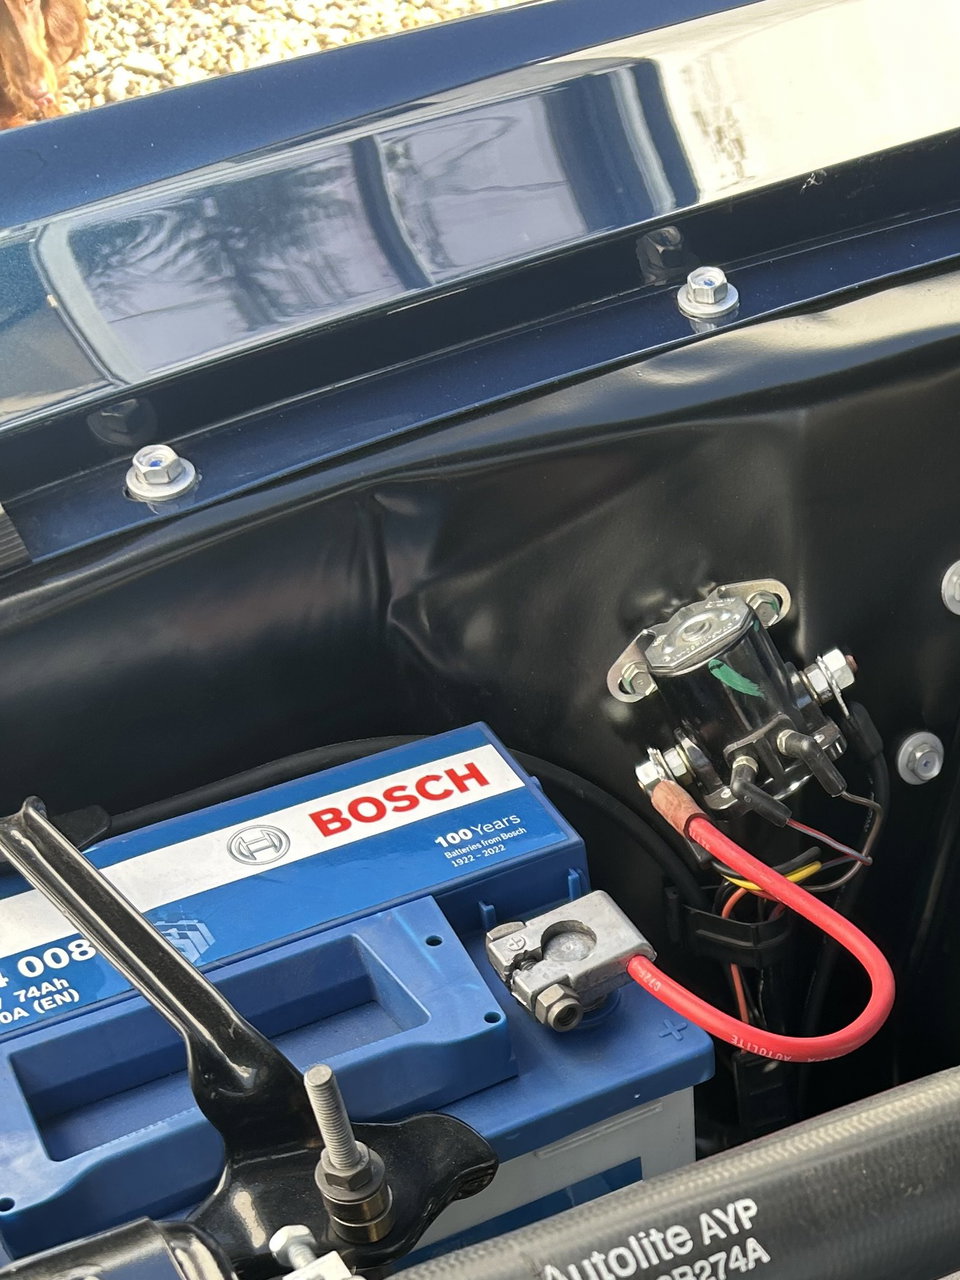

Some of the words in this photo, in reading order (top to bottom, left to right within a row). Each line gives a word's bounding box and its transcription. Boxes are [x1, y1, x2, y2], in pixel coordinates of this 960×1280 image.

[308, 763, 490, 837] BOSCH
[444, 842, 482, 859] Batteries
[482, 835, 501, 846] from
[500, 827, 528, 840] Bosch
[451, 854, 475, 868] 1922
[482, 844, 506, 857] 2022
[17, 939, 97, 978] 008
[12, 978, 70, 1003] 74Ah
[33, 988, 80, 1014] (EN)
[730, 1034, 792, 1062] AUTOLITE
[699, 1198, 758, 1246] AYP
